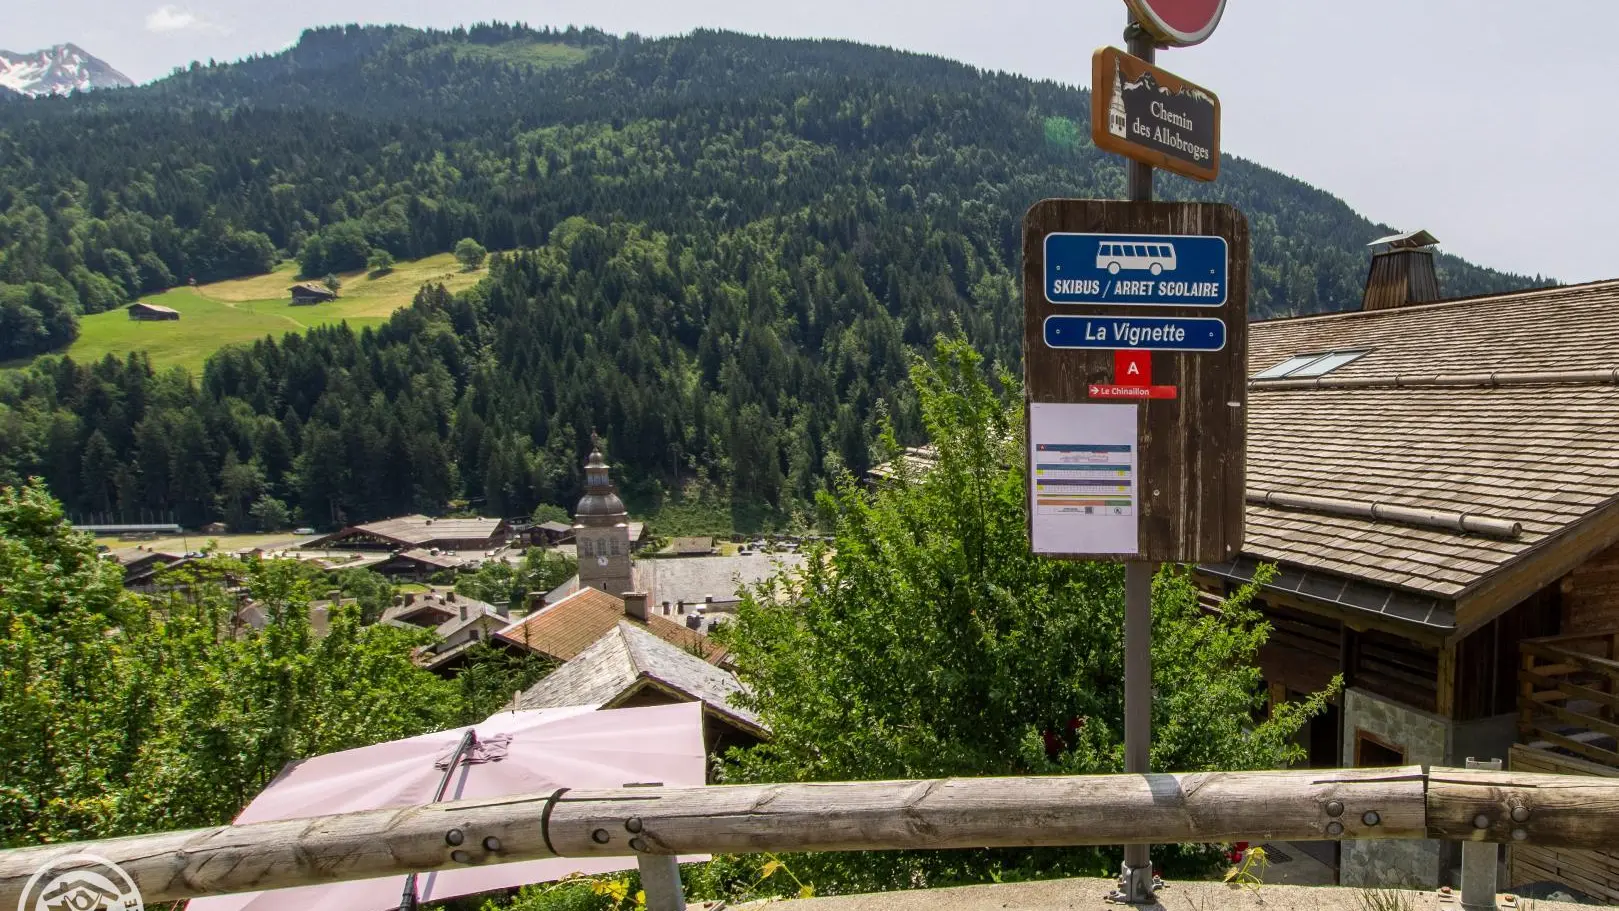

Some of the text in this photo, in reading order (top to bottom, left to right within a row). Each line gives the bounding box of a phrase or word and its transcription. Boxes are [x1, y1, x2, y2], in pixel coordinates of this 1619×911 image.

[1151, 101, 1193, 131] Chemin
[1132, 118, 1209, 160] des Allobroges
[1053, 280, 1219, 298] SKIBUS / ARRET SCOLAIRE
[1085, 322, 1185, 345] La Vignette
[1127, 361, 1139, 375] A
[1101, 387, 1150, 396] Le Chinaillon
